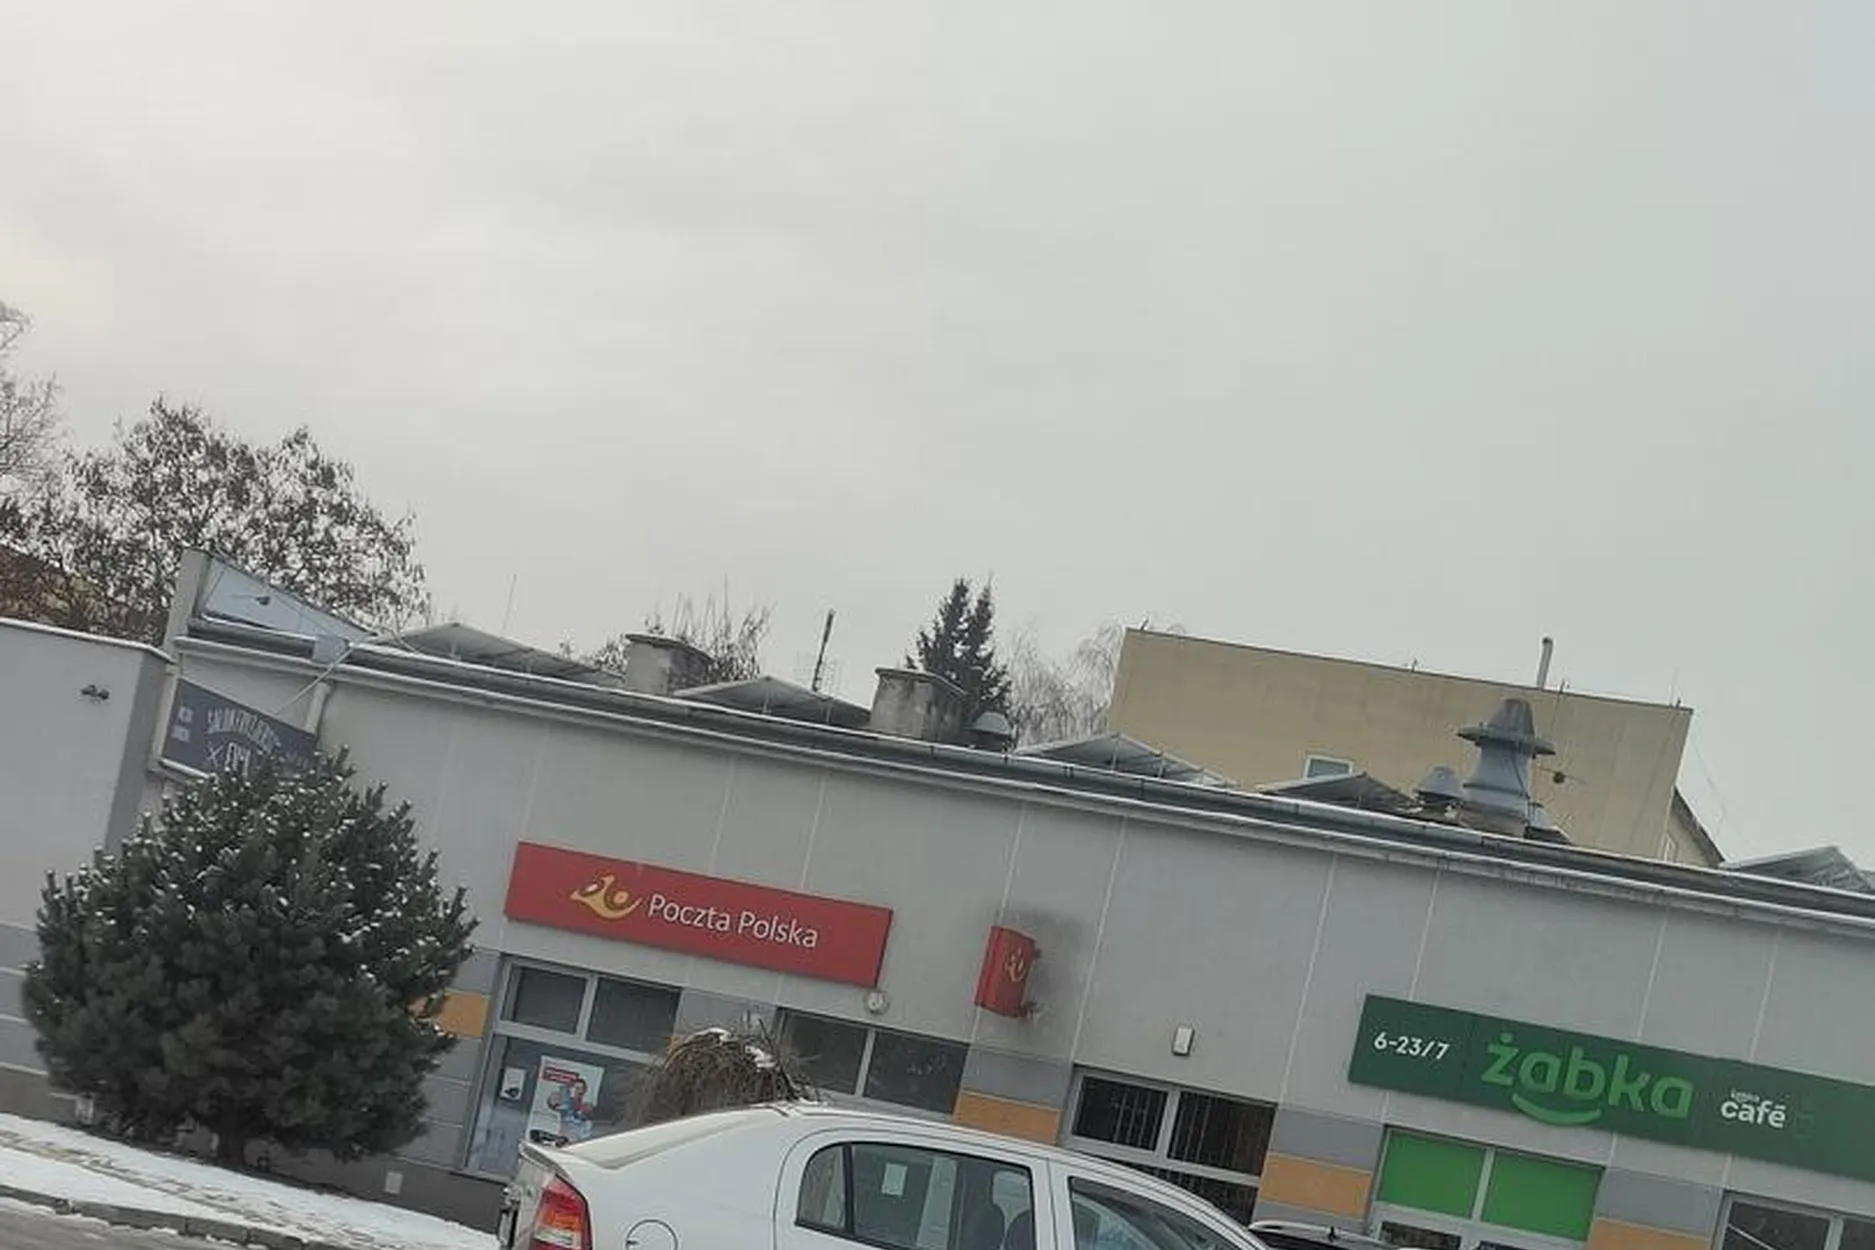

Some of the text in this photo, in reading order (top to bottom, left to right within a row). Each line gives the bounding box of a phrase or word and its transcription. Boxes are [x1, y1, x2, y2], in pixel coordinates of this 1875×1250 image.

[648, 893, 818, 948] Poczta Polska
[1373, 1031, 1450, 1060] 6-23/7
[1481, 1032, 1694, 1119] żabka
[1720, 1099, 1787, 1129] café
